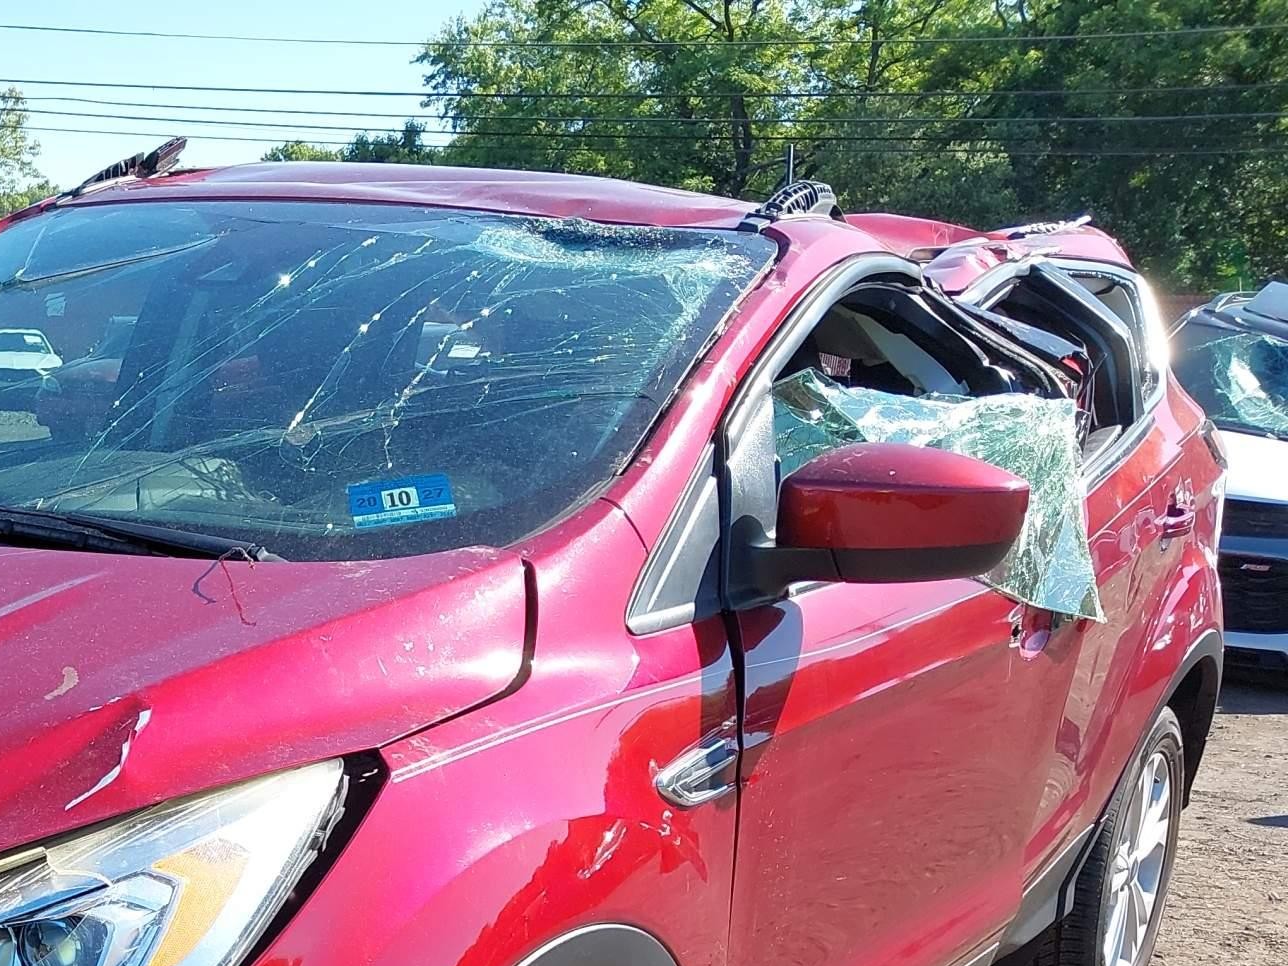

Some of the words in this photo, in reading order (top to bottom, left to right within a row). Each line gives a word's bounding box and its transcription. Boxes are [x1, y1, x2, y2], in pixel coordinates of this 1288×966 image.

[357, 496, 377, 509] 20
[386, 490, 412, 508] 10
[422, 487, 444, 500] 27
